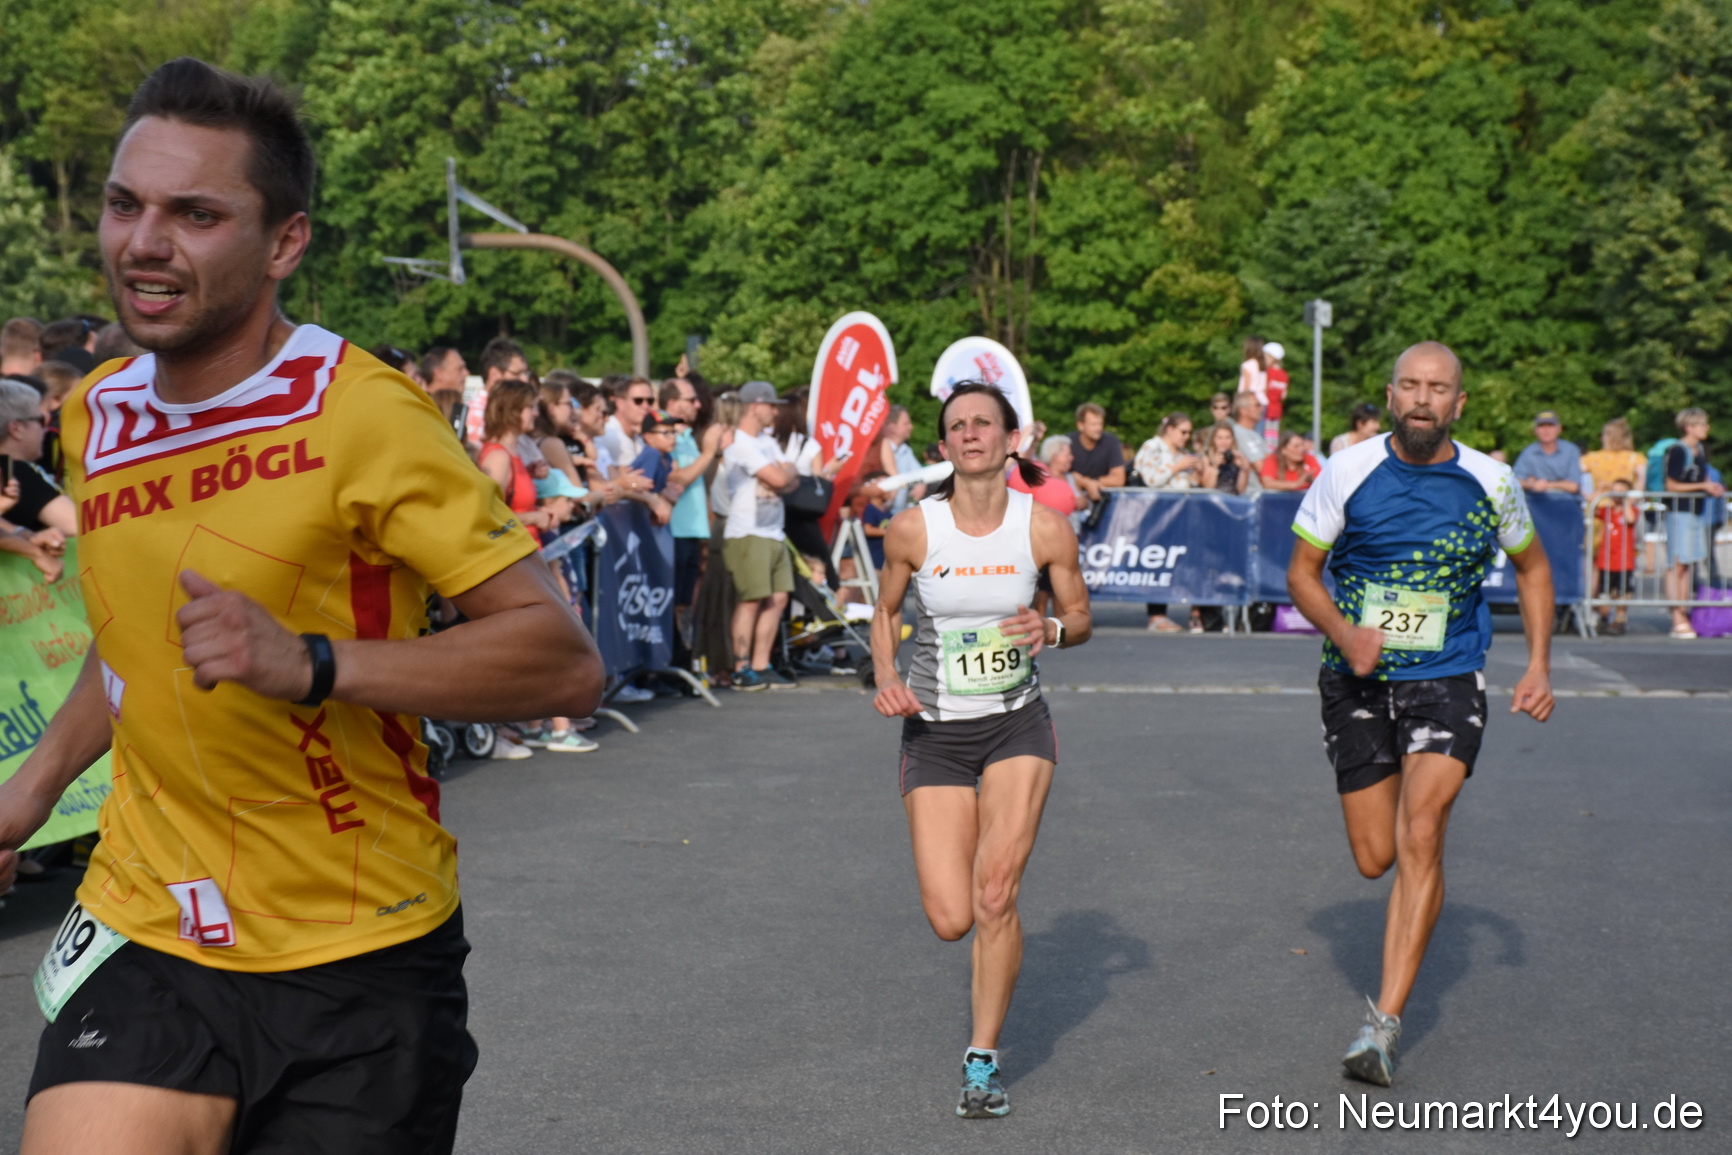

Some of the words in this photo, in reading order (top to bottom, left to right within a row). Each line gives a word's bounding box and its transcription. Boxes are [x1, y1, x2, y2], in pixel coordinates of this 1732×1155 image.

[81, 474, 175, 536] MAX
[190, 438, 326, 503] BÖGL
[955, 565, 1021, 577] KLEBL
[1083, 570, 1173, 587] OMOBILE
[1379, 609, 1428, 633] 237
[956, 647, 1021, 676] 1159
[0, 680, 48, 763] auf
